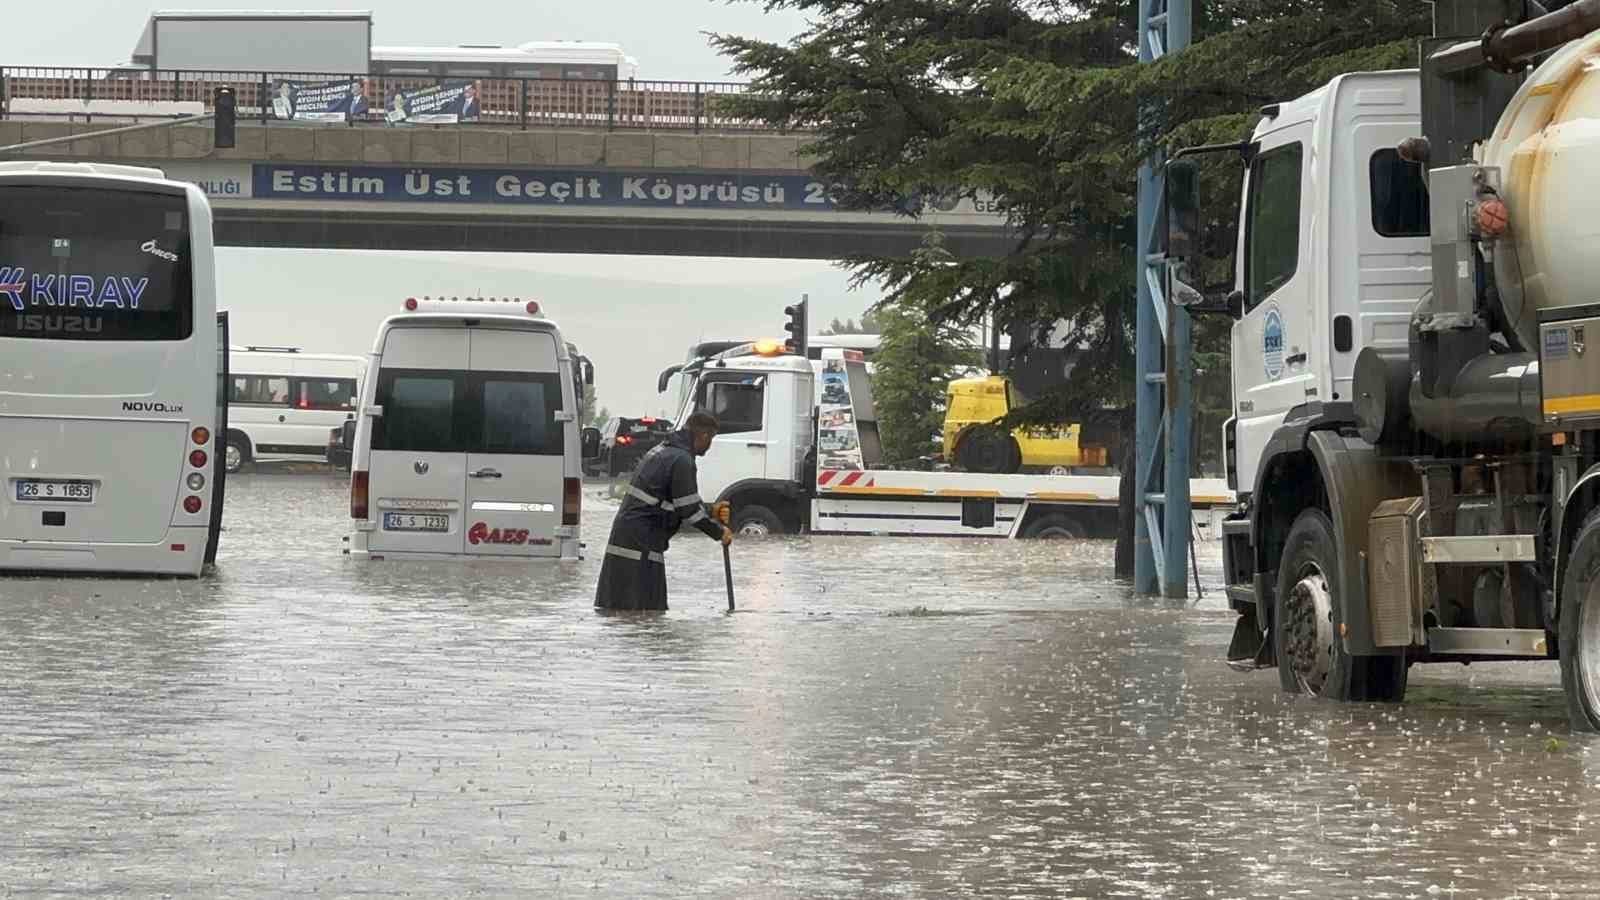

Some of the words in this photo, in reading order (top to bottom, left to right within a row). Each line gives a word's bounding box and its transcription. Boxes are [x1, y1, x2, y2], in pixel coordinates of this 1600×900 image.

[273, 170, 384, 194] Estim
[405, 169, 472, 196] Üst
[495, 175, 602, 203] Geçit
[622, 177, 785, 205] Köprüsü
[31, 273, 149, 309] KIRAY
[16, 315, 103, 332] ISUZU
[23, 484, 39, 496] 26
[46, 484, 54, 496] S
[62, 485, 89, 497] 1853
[391, 515, 402, 526] 26
[408, 516, 416, 527] S
[424, 517, 446, 528] 1239
